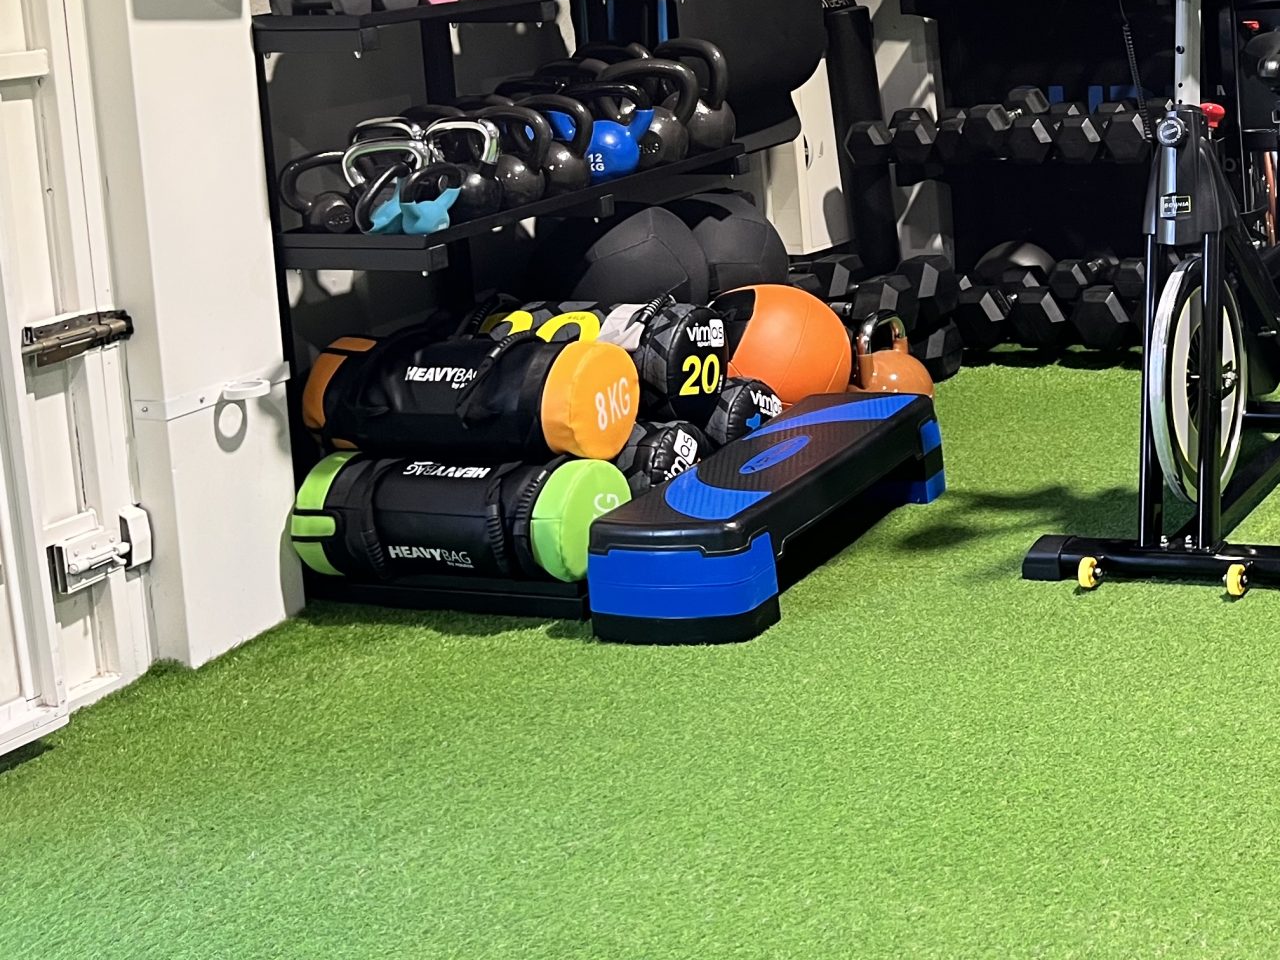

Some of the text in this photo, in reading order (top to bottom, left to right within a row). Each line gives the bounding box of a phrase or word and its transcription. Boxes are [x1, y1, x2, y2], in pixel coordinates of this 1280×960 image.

[588, 153, 603, 162] 12
[686, 323, 724, 342] vimas
[679, 353, 720, 396] 20
[402, 464, 491, 479] HEAVYBAG
[388, 545, 472, 564] HEAVYBAG
